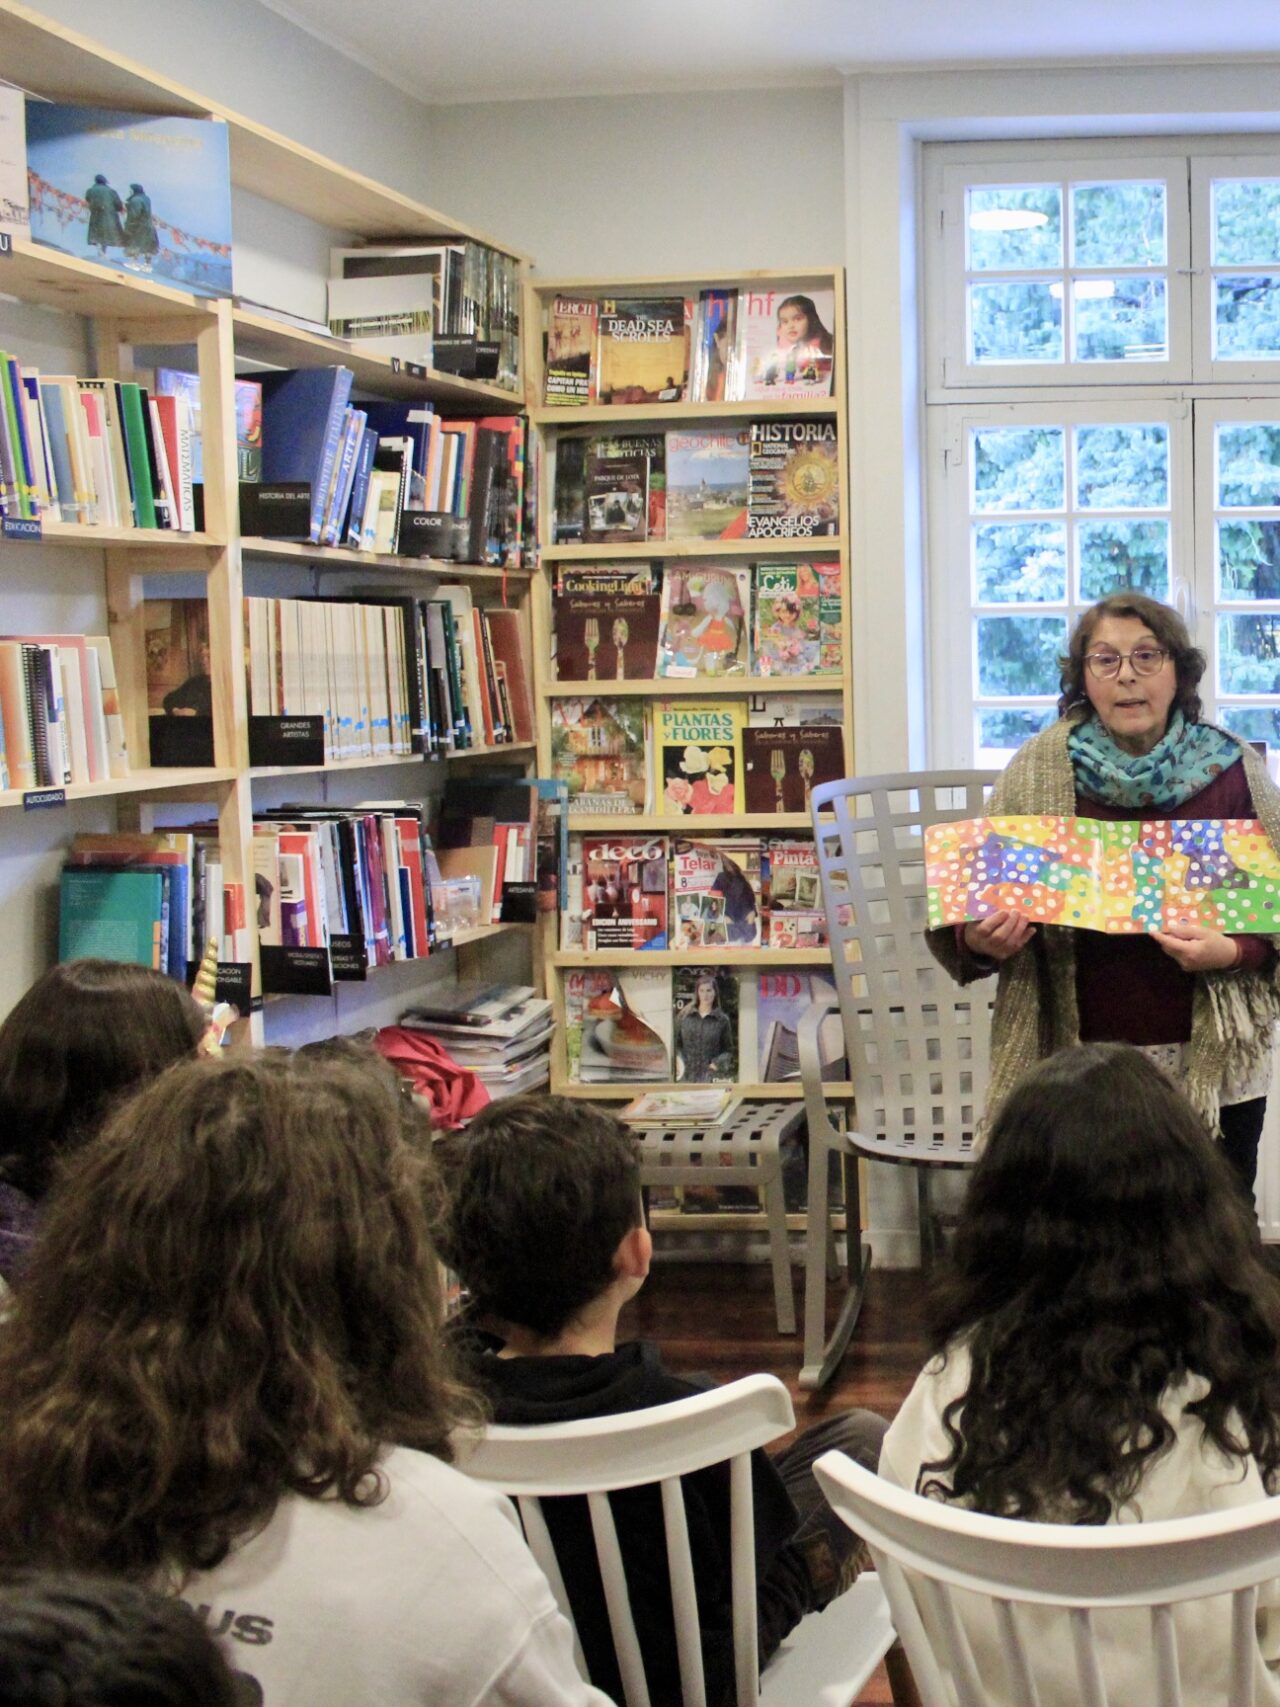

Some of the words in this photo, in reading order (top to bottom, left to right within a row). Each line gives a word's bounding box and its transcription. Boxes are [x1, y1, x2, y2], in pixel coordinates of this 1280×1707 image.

[748, 291, 775, 316] hf
[608, 320, 645, 332] DEAD
[647, 320, 674, 332] SEA
[612, 331, 671, 343] SCROLLS
[752, 424, 836, 441] HISTORIA
[414, 517, 441, 526] COLOR
[749, 516, 820, 527] EVANGELIOS
[748, 527, 813, 537] APOCRIFOS
[662, 713, 733, 726] PLANTAS
[280, 722, 311, 730] GRANDES
[672, 727, 734, 741] FLORES
[680, 857, 716, 870] Telar
[681, 878, 687, 887] 8
